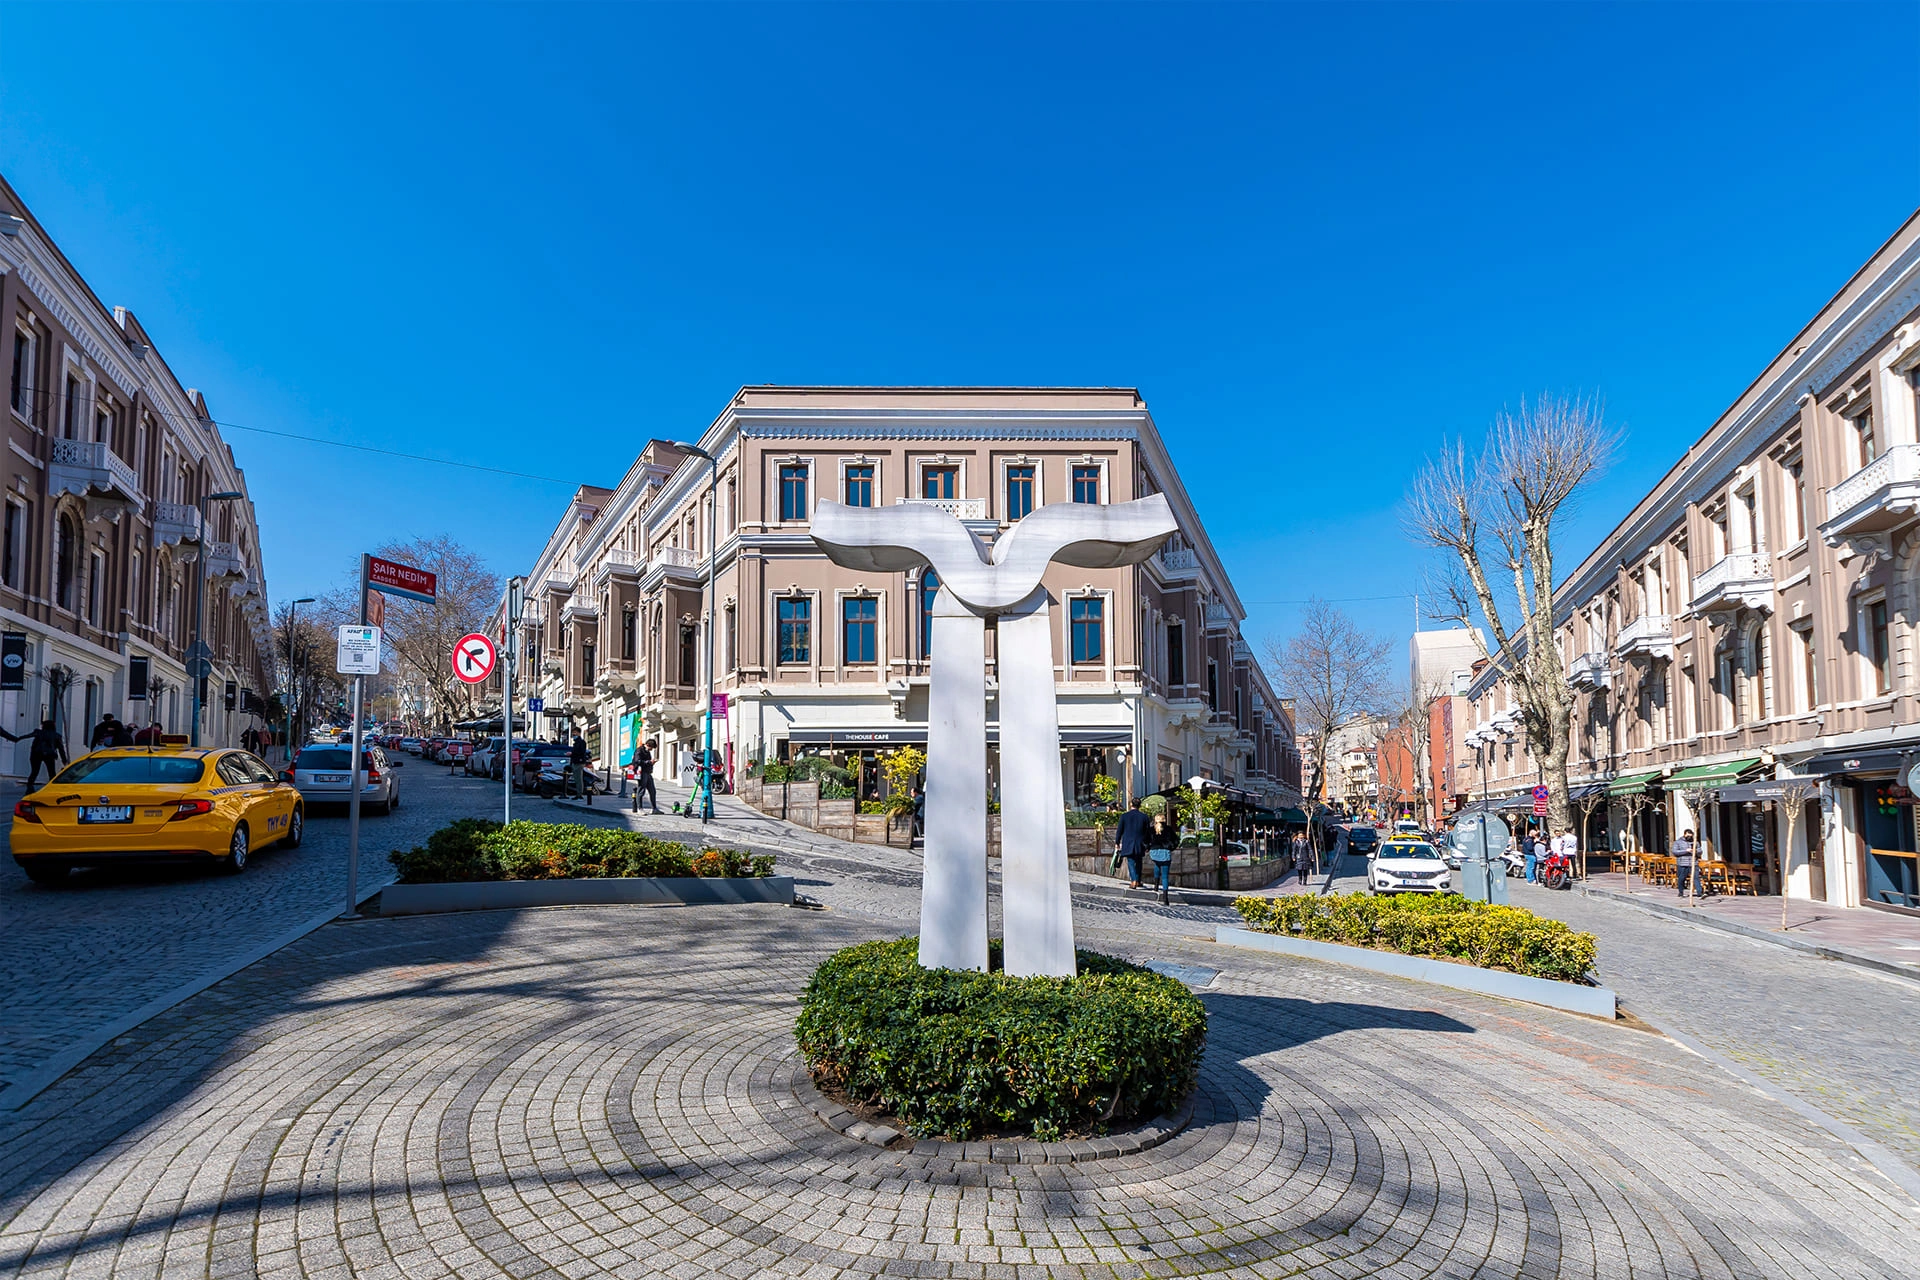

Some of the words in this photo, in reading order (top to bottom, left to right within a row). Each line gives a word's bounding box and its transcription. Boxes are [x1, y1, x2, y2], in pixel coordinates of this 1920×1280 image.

[373, 562, 396, 577] ŞAİR
[397, 569, 427, 585] NEDİM
[267, 816, 280, 832] THY
